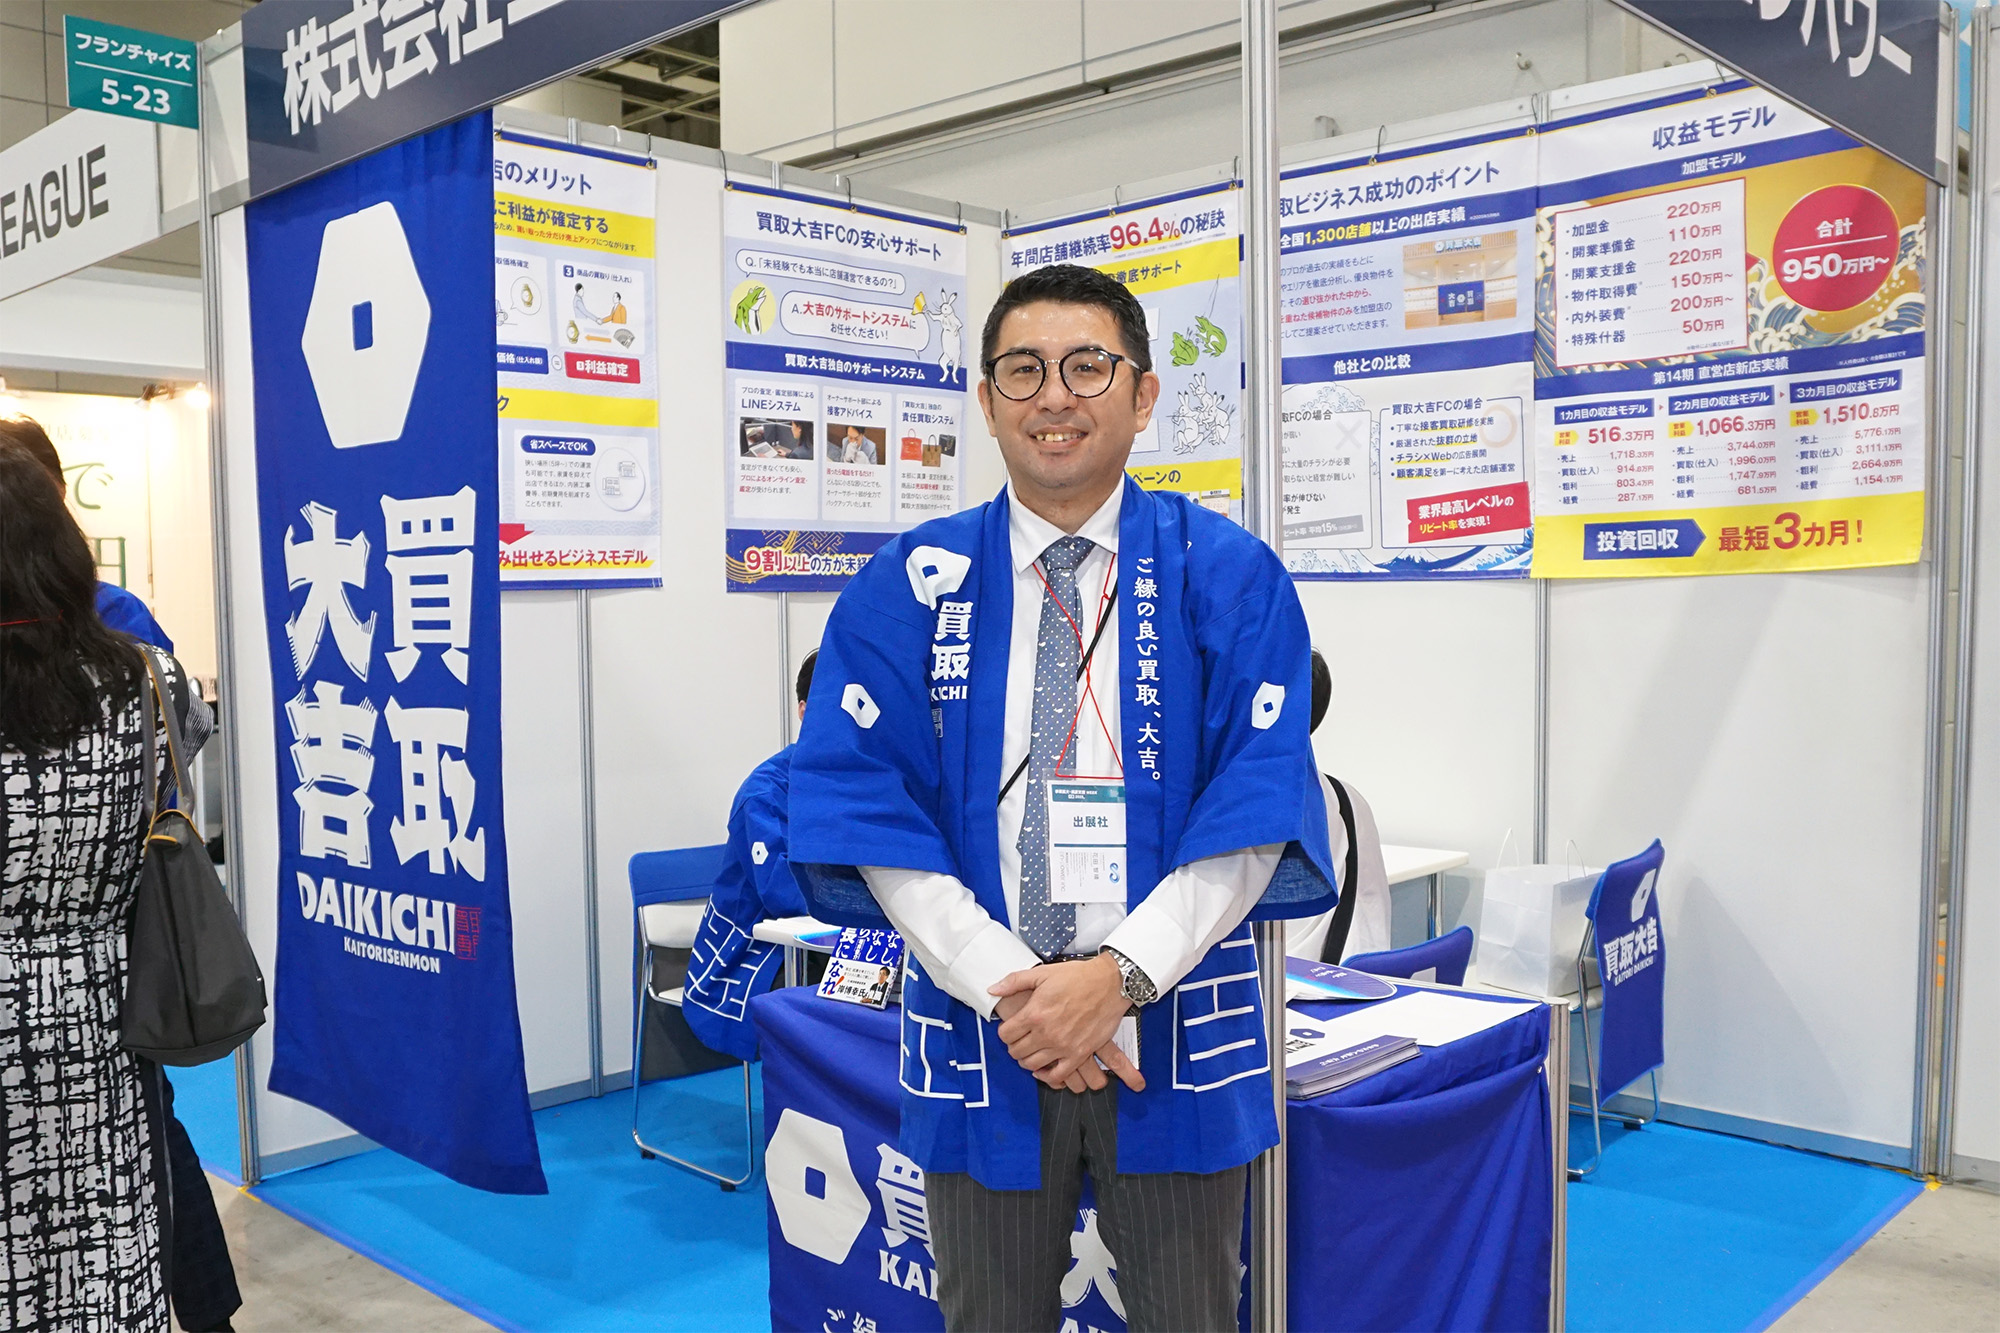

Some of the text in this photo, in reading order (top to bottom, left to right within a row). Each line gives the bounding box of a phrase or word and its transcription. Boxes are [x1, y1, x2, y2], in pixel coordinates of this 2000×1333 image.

[75, 32, 191, 72] フランチャイズ
[283, 0, 566, 135] 株式会社
[101, 78, 171, 115] 5-23
[1652, 105, 1776, 150] 収益モデル
[1682, 152, 1746, 175] 加盟モデル
[0, 144, 109, 260] EAGUE
[1572, 201, 1722, 237] 加盟金 220万円
[1816, 217, 1853, 239] 合計
[757, 211, 942, 262] 買取大吉FCの安心サポート
[1572, 224, 1722, 259] 開業準備金 110万円
[1571, 248, 1722, 281] 開業支援金 220万円
[1571, 319, 1725, 346] 特殊什器 50万円
[785, 353, 926, 380] 買取大吉独自のサポートシステム
[1334, 354, 1411, 375] 他社との比較
[1653, 357, 1789, 385] 第14期 直営店新店実績
[741, 399, 801, 413] LINEシステム
[827, 405, 873, 419] 接客アドバイス
[1392, 398, 1483, 415] 買取大吉FCの場合
[1823, 403, 1900, 425] 1,510.8万円
[901, 413, 954, 425] 責任買取システム
[1697, 416, 1776, 437] 1,066.3万円
[530, 439, 588, 451] 省スペースでOK
[1588, 426, 1654, 444] 516.3万円
[1800, 435, 1819, 445] 売上
[1561, 450, 1654, 463] 売上 1,718.3万円
[1676, 441, 1776, 455] 売上 3,744.0万円
[1282, 457, 1351, 469] に大量のチラシが必要
[1418, 495, 1514, 519] 業界最高レベルの
[1597, 528, 1679, 551] 投資回収
[745, 549, 873, 573] 9割以上の方が未経
[931, 601, 973, 681] 買取
[1073, 815, 1109, 828] 出展社
[296, 871, 456, 955] DAIKICHI
[344, 936, 440, 974] KAITORISENMON
[1603, 916, 1658, 981] 買取大吉
